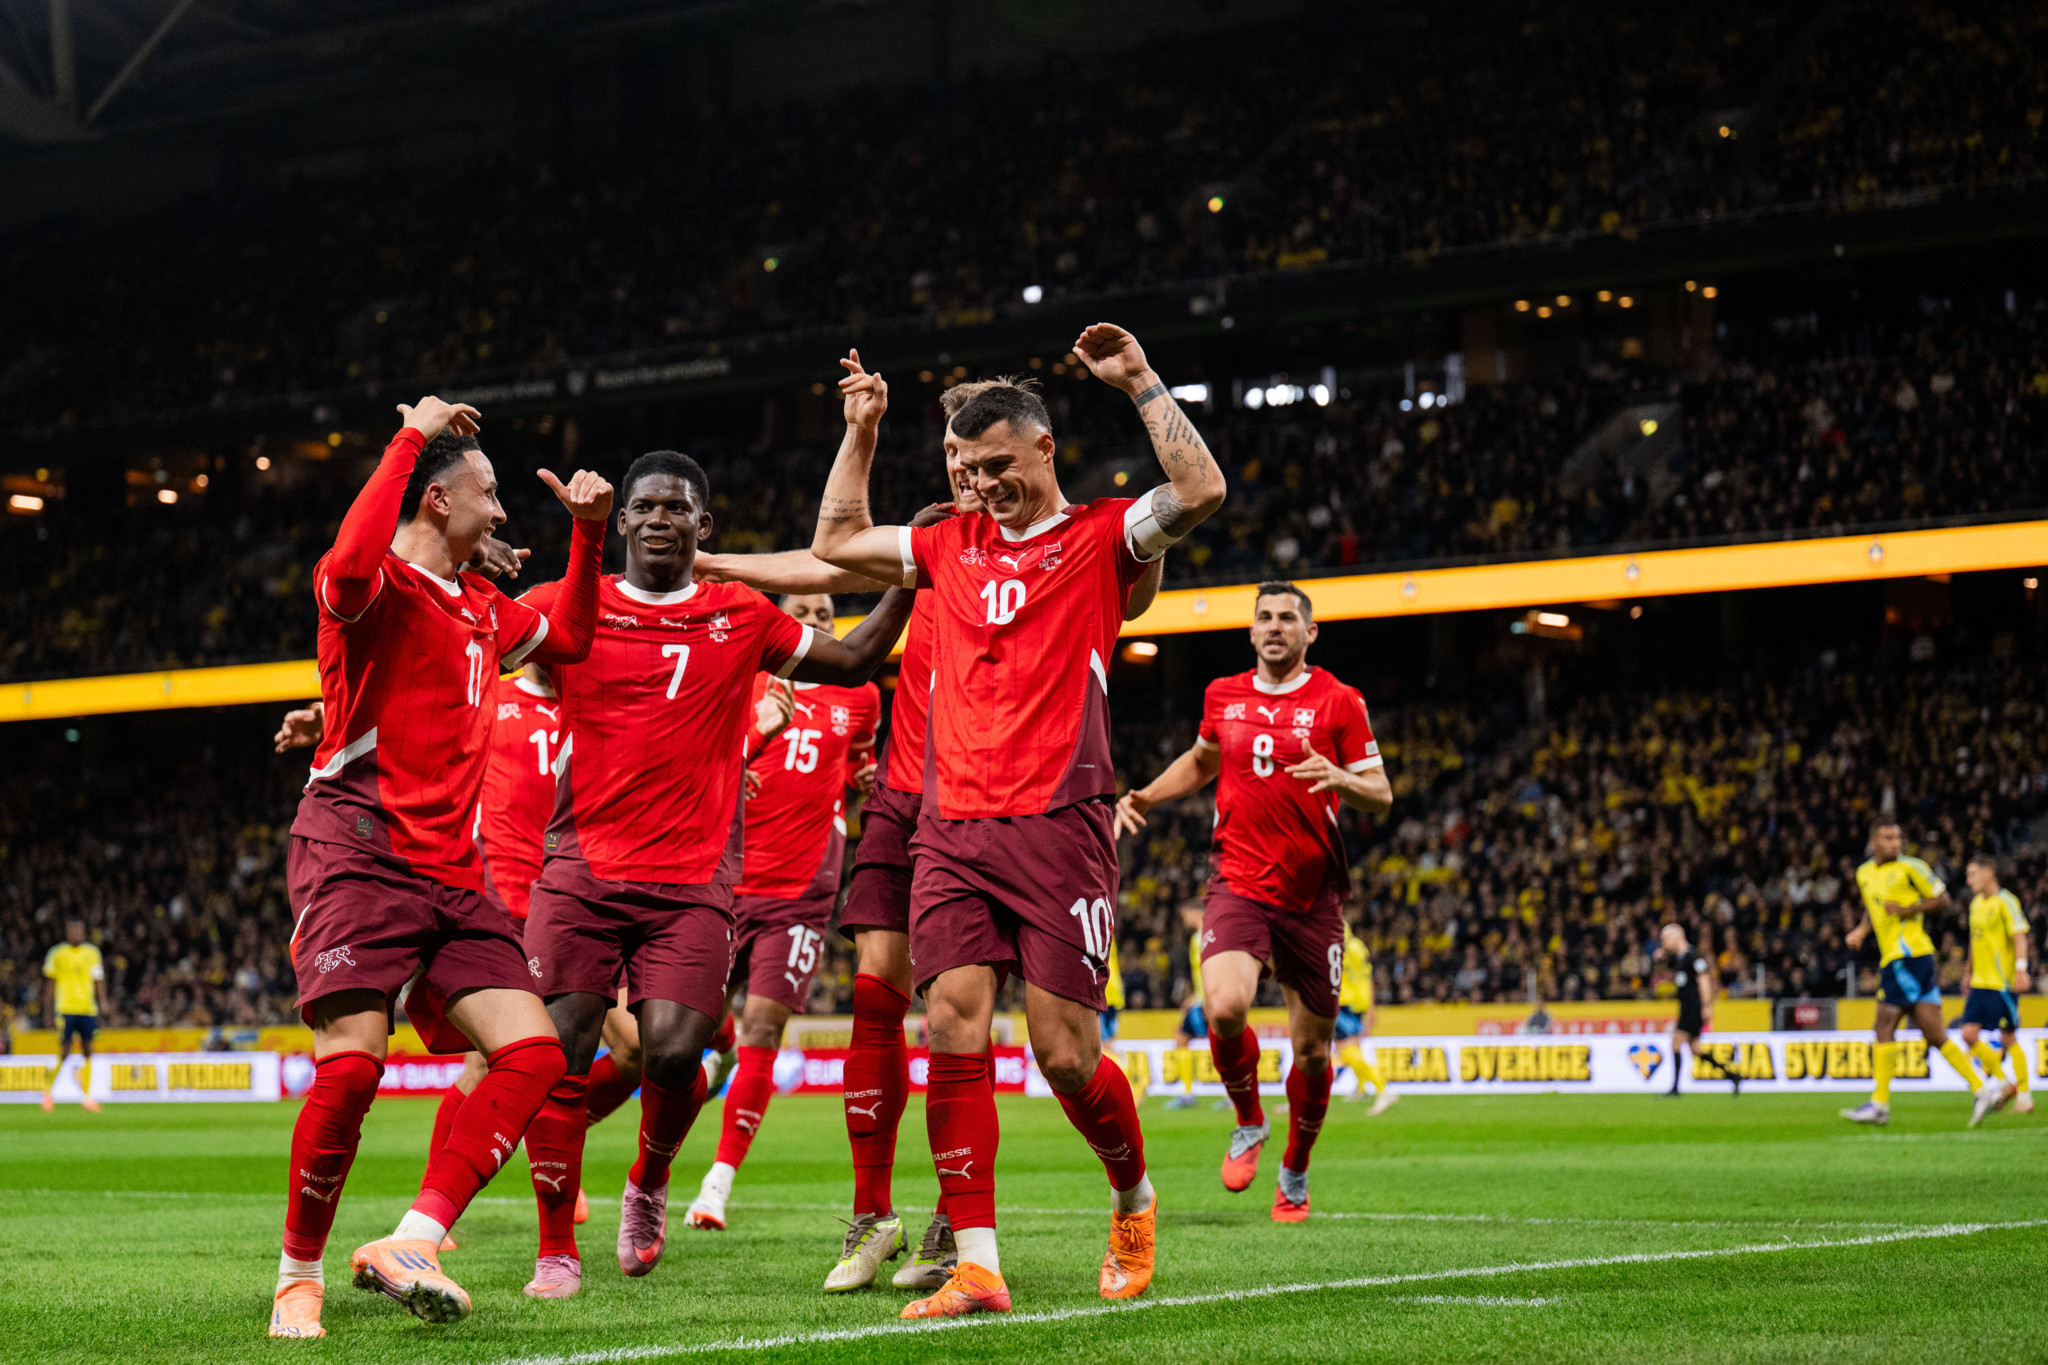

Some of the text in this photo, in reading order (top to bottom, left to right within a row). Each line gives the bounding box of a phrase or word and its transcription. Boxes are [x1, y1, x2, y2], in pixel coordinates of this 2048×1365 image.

[980, 579, 1026, 625] 10
[662, 644, 690, 699] 7
[783, 727, 822, 773] 15
[1253, 733, 1274, 777] 8
[787, 924, 820, 973] 15
[1070, 897, 1110, 960] 10
[1327, 943, 1342, 987] 8
[1375, 1045, 1591, 1082] HEJA SVERIGE
[1784, 1038, 1931, 1080] SVERE
[844, 1089, 883, 1098] SUISSE
[933, 1147, 972, 1161] SUISSE
